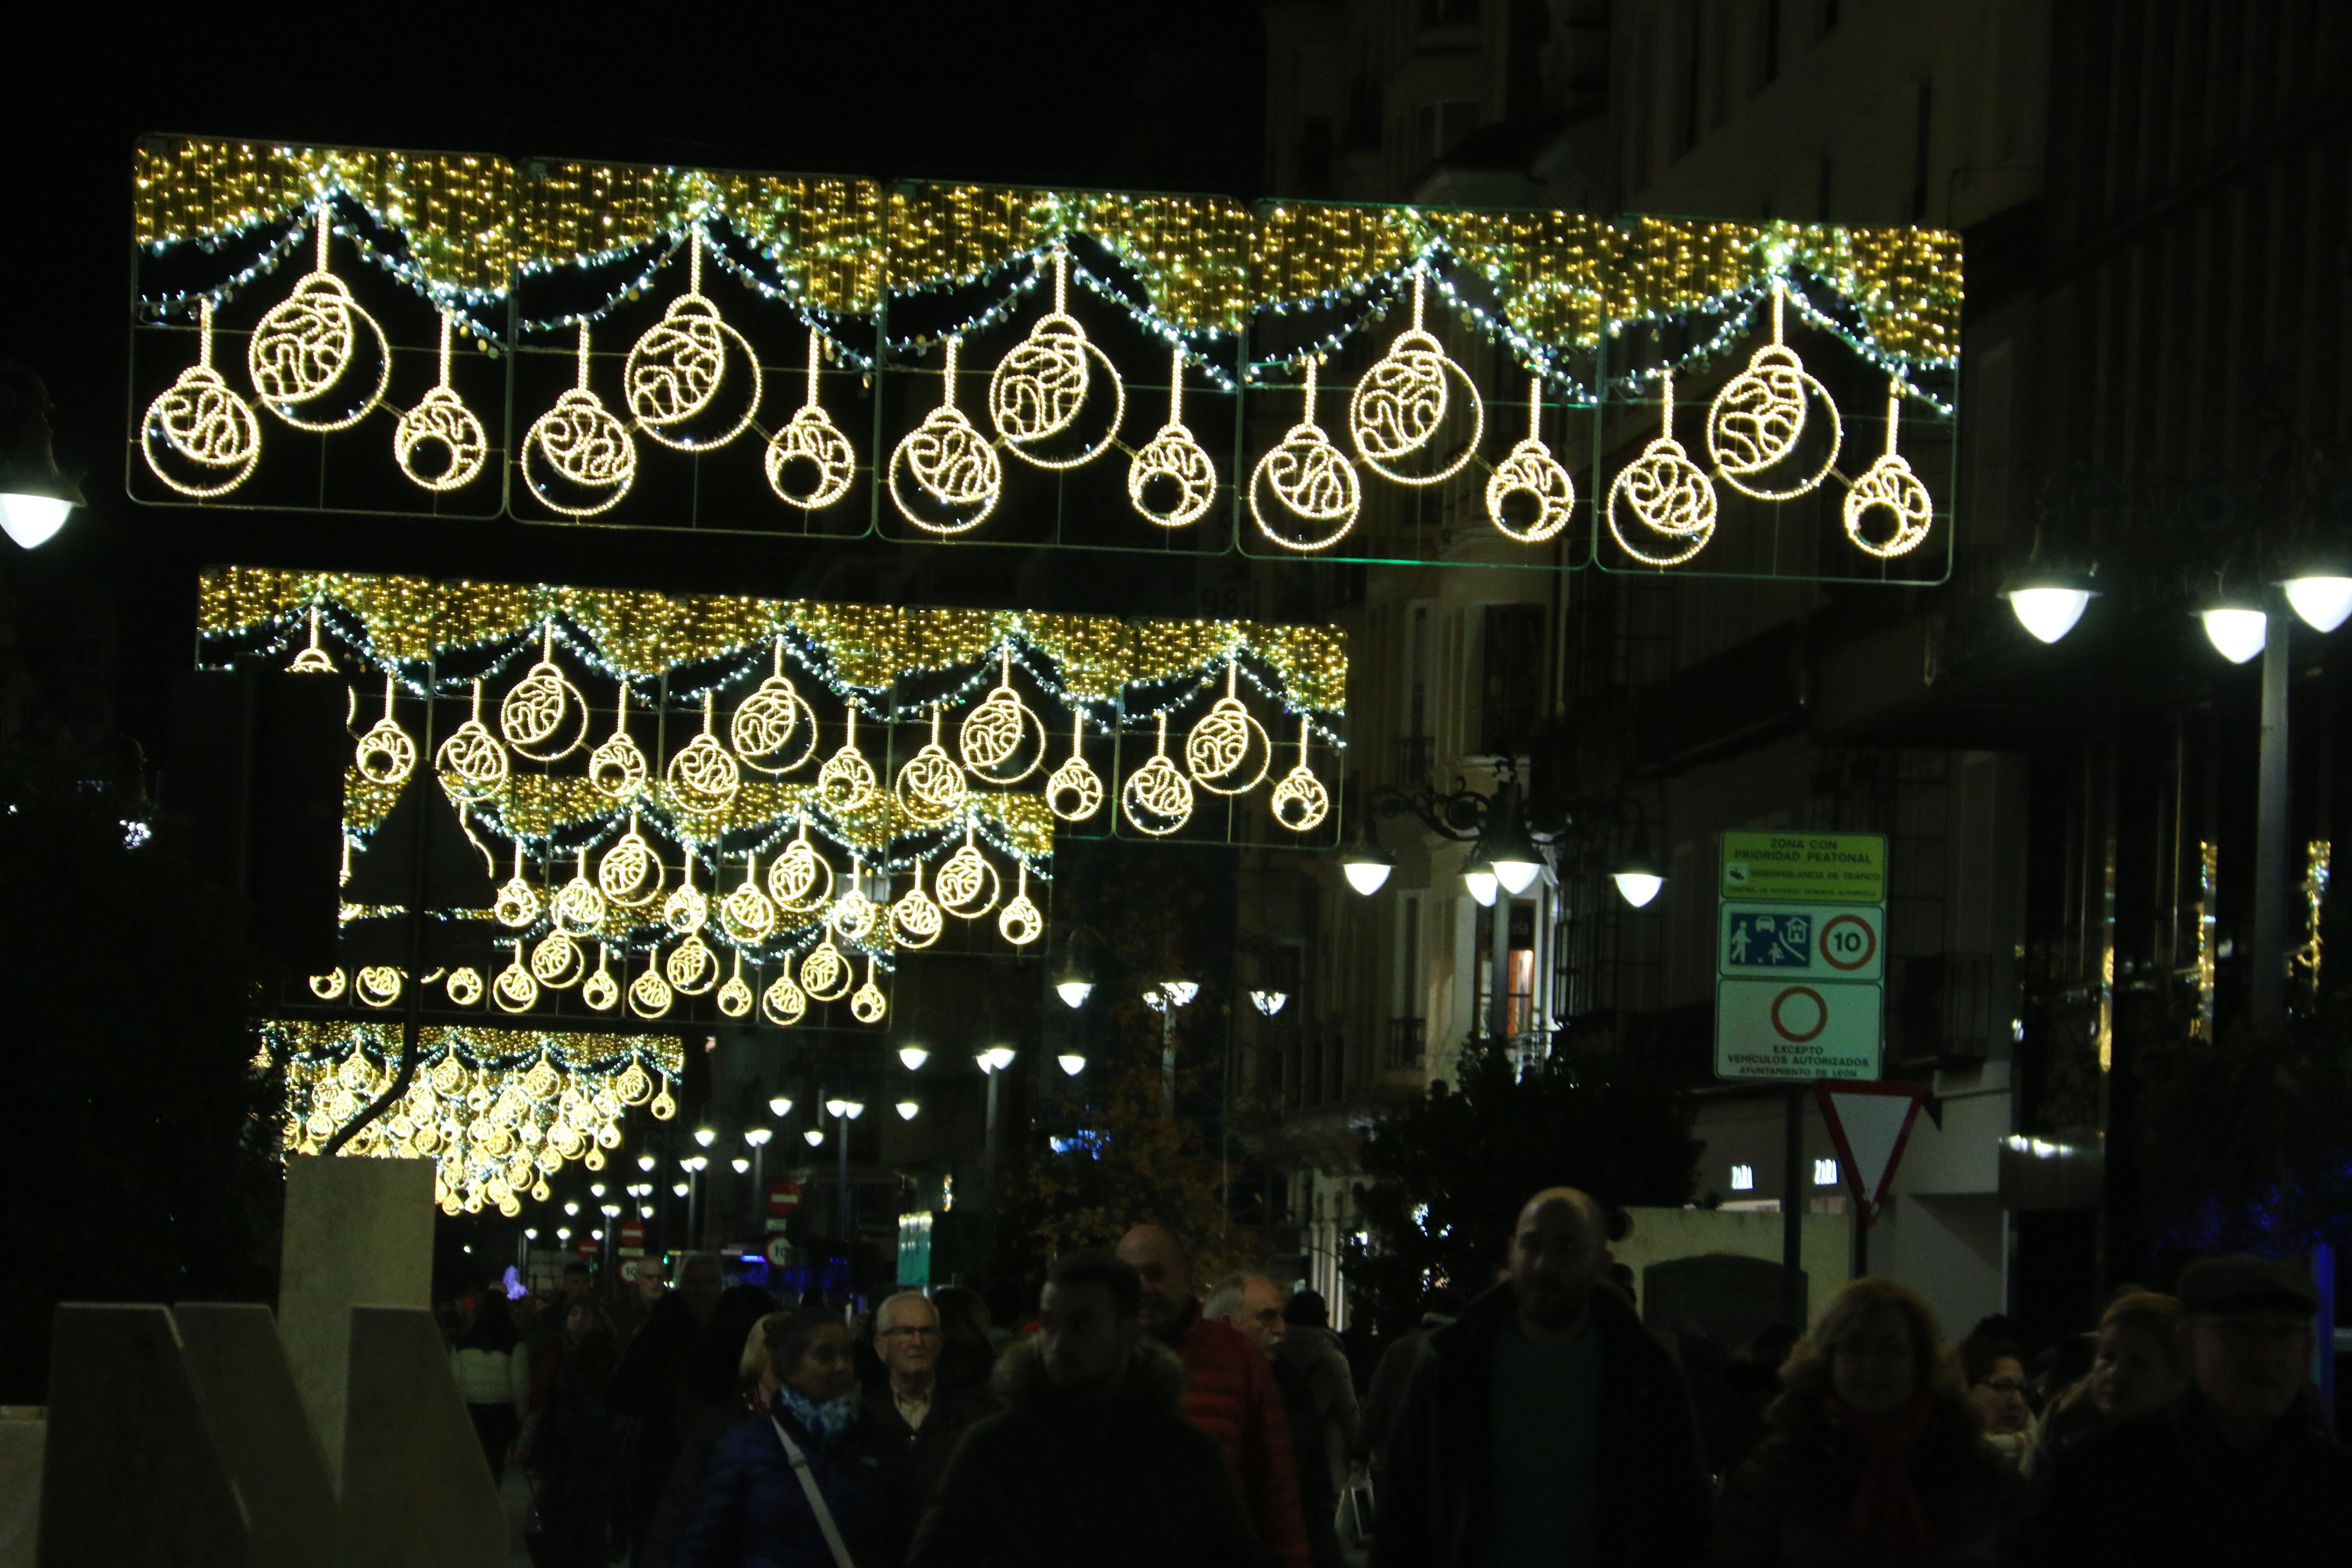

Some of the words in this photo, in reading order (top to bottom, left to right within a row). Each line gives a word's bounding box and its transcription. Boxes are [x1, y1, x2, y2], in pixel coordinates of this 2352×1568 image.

[1770, 838, 1804, 849] ZONA
[1809, 839, 1838, 850] CON
[1734, 849, 1801, 861] PRIORIDAD
[1807, 851, 1872, 864] PEATONAL
[1828, 871, 1839, 880] DE
[1834, 932, 1861, 952] 10
[1773, 1044, 1824, 1055] EXCEPTO
[1792, 1056, 1869, 1067] AUTORIZADOS
[1740, 1066, 1811, 1076] AYUNTAMIENTO
[1816, 1068, 1828, 1077] DE
